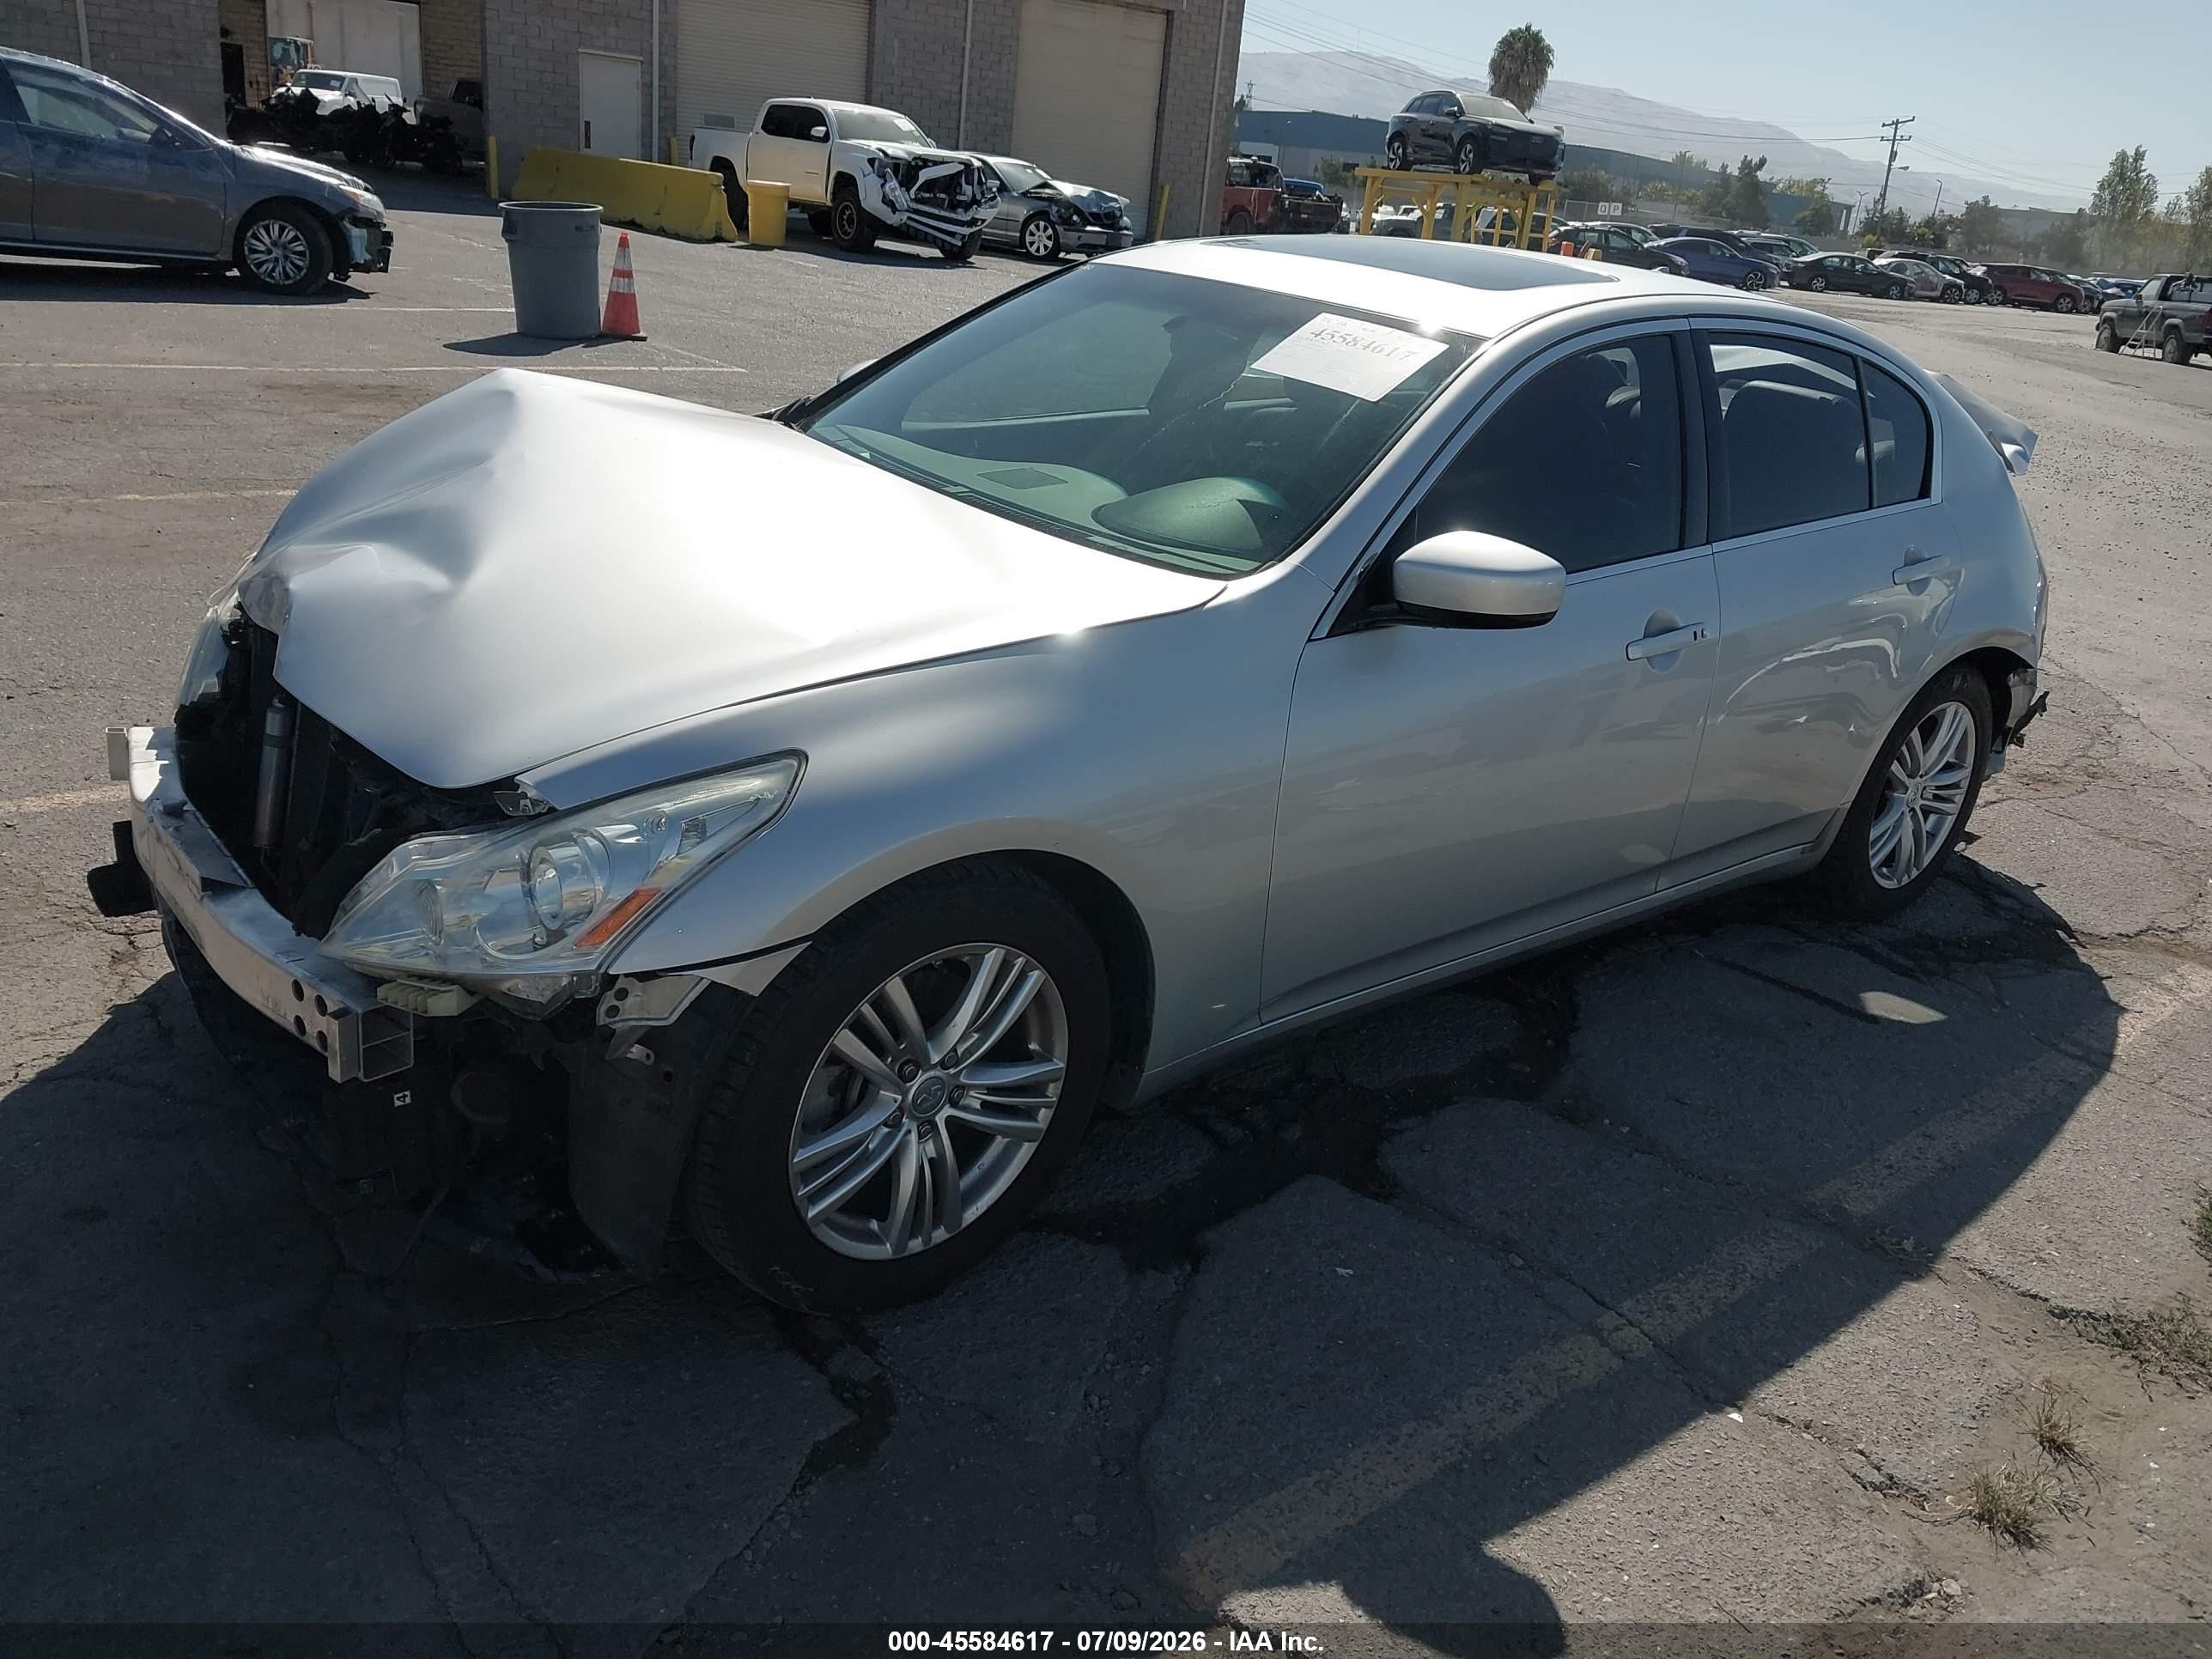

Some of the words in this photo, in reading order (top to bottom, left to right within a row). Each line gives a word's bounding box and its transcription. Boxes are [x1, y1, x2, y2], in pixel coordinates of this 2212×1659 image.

[1613, 205, 1620, 214] P
[1310, 327, 1420, 362] 45584617
[396, 1092, 408, 1103] 4
